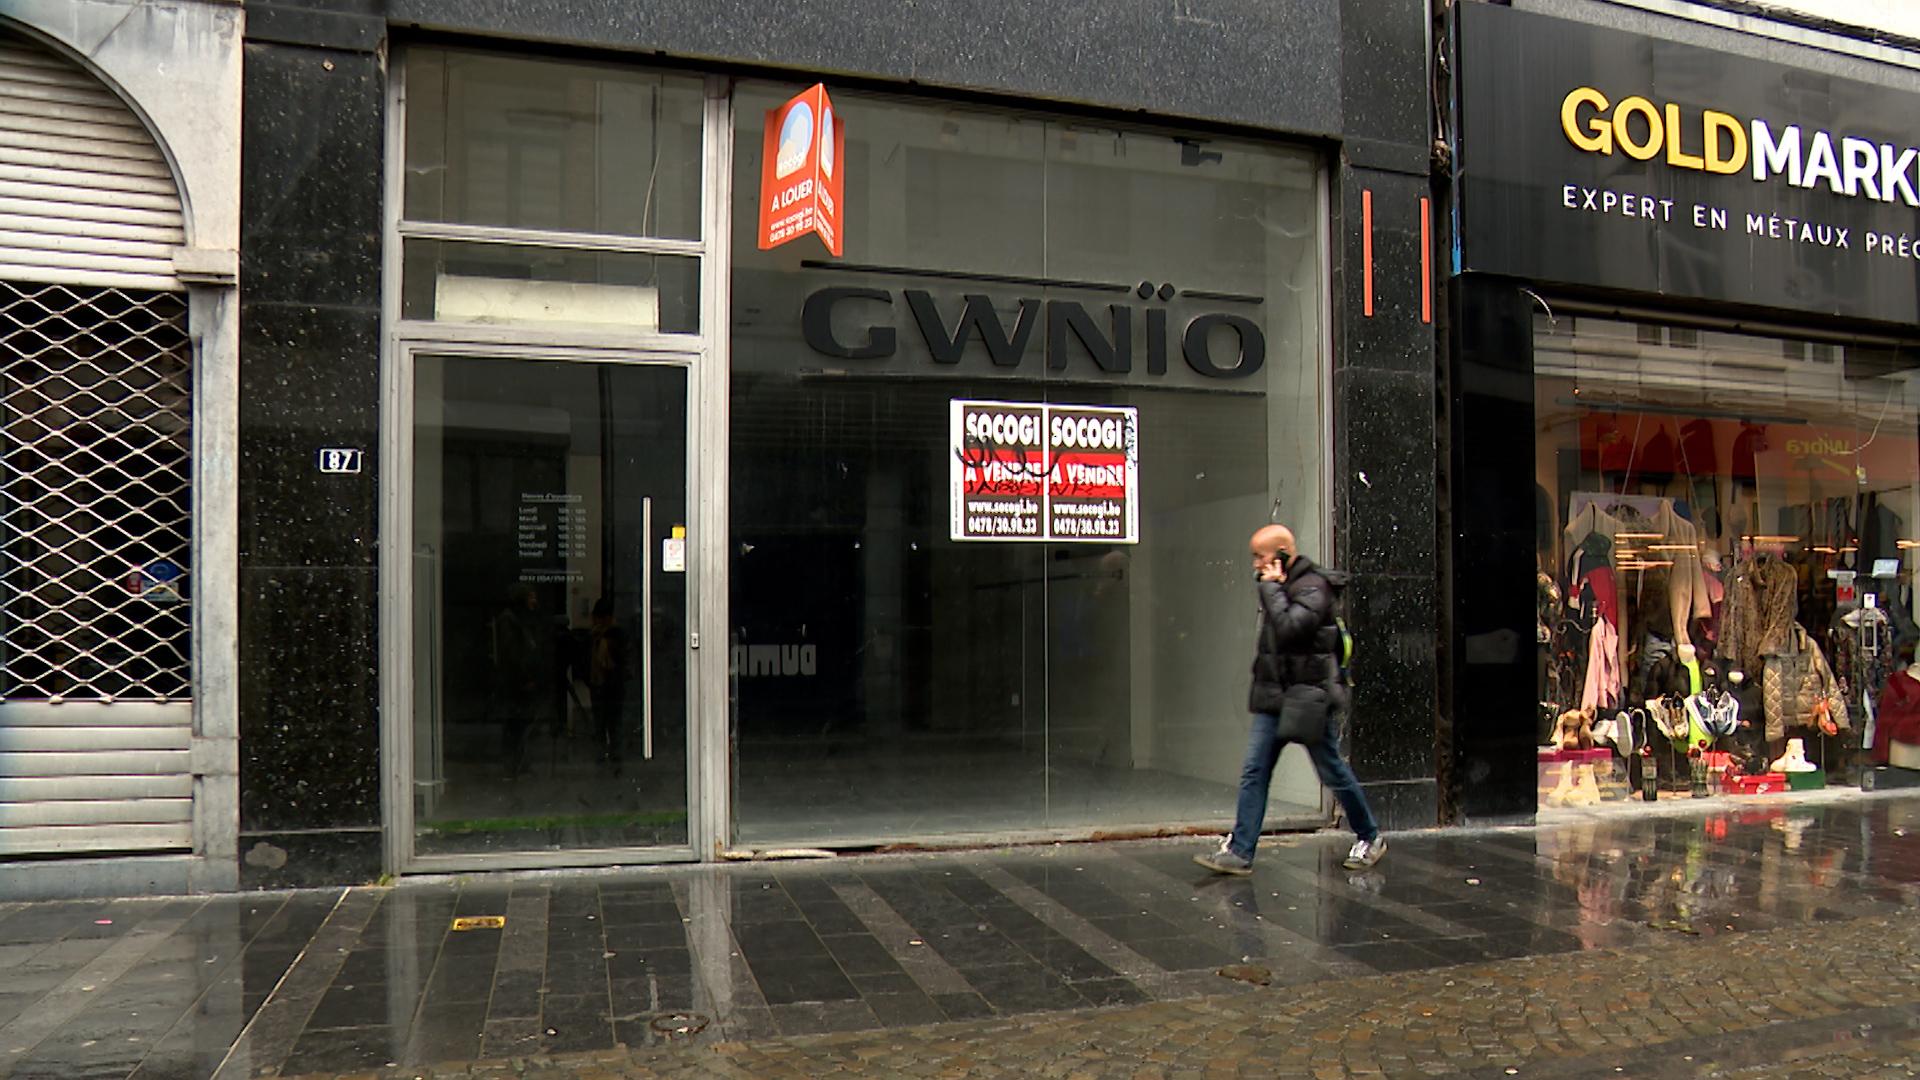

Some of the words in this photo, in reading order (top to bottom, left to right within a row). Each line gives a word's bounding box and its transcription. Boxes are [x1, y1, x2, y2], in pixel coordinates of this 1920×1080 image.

[1560, 86, 1920, 208] GOLDMARK
[771, 194, 781, 213] A
[781, 178, 813, 208] LOUER
[1562, 184, 1674, 223] EXPERT
[1692, 204, 1729, 232] EN
[1745, 212, 1850, 250] MÉTAUX
[965, 412, 1041, 446] SOCOGI
[1051, 416, 1123, 450] SOCOGI
[328, 449, 353, 470] 87
[982, 461, 1042, 484] VENDRE
[1051, 462, 1063, 484] A
[1066, 463, 1125, 487] VENDRE
[967, 498, 1039, 517] www.socogi.be
[1053, 500, 1121, 518] www.socogi.be
